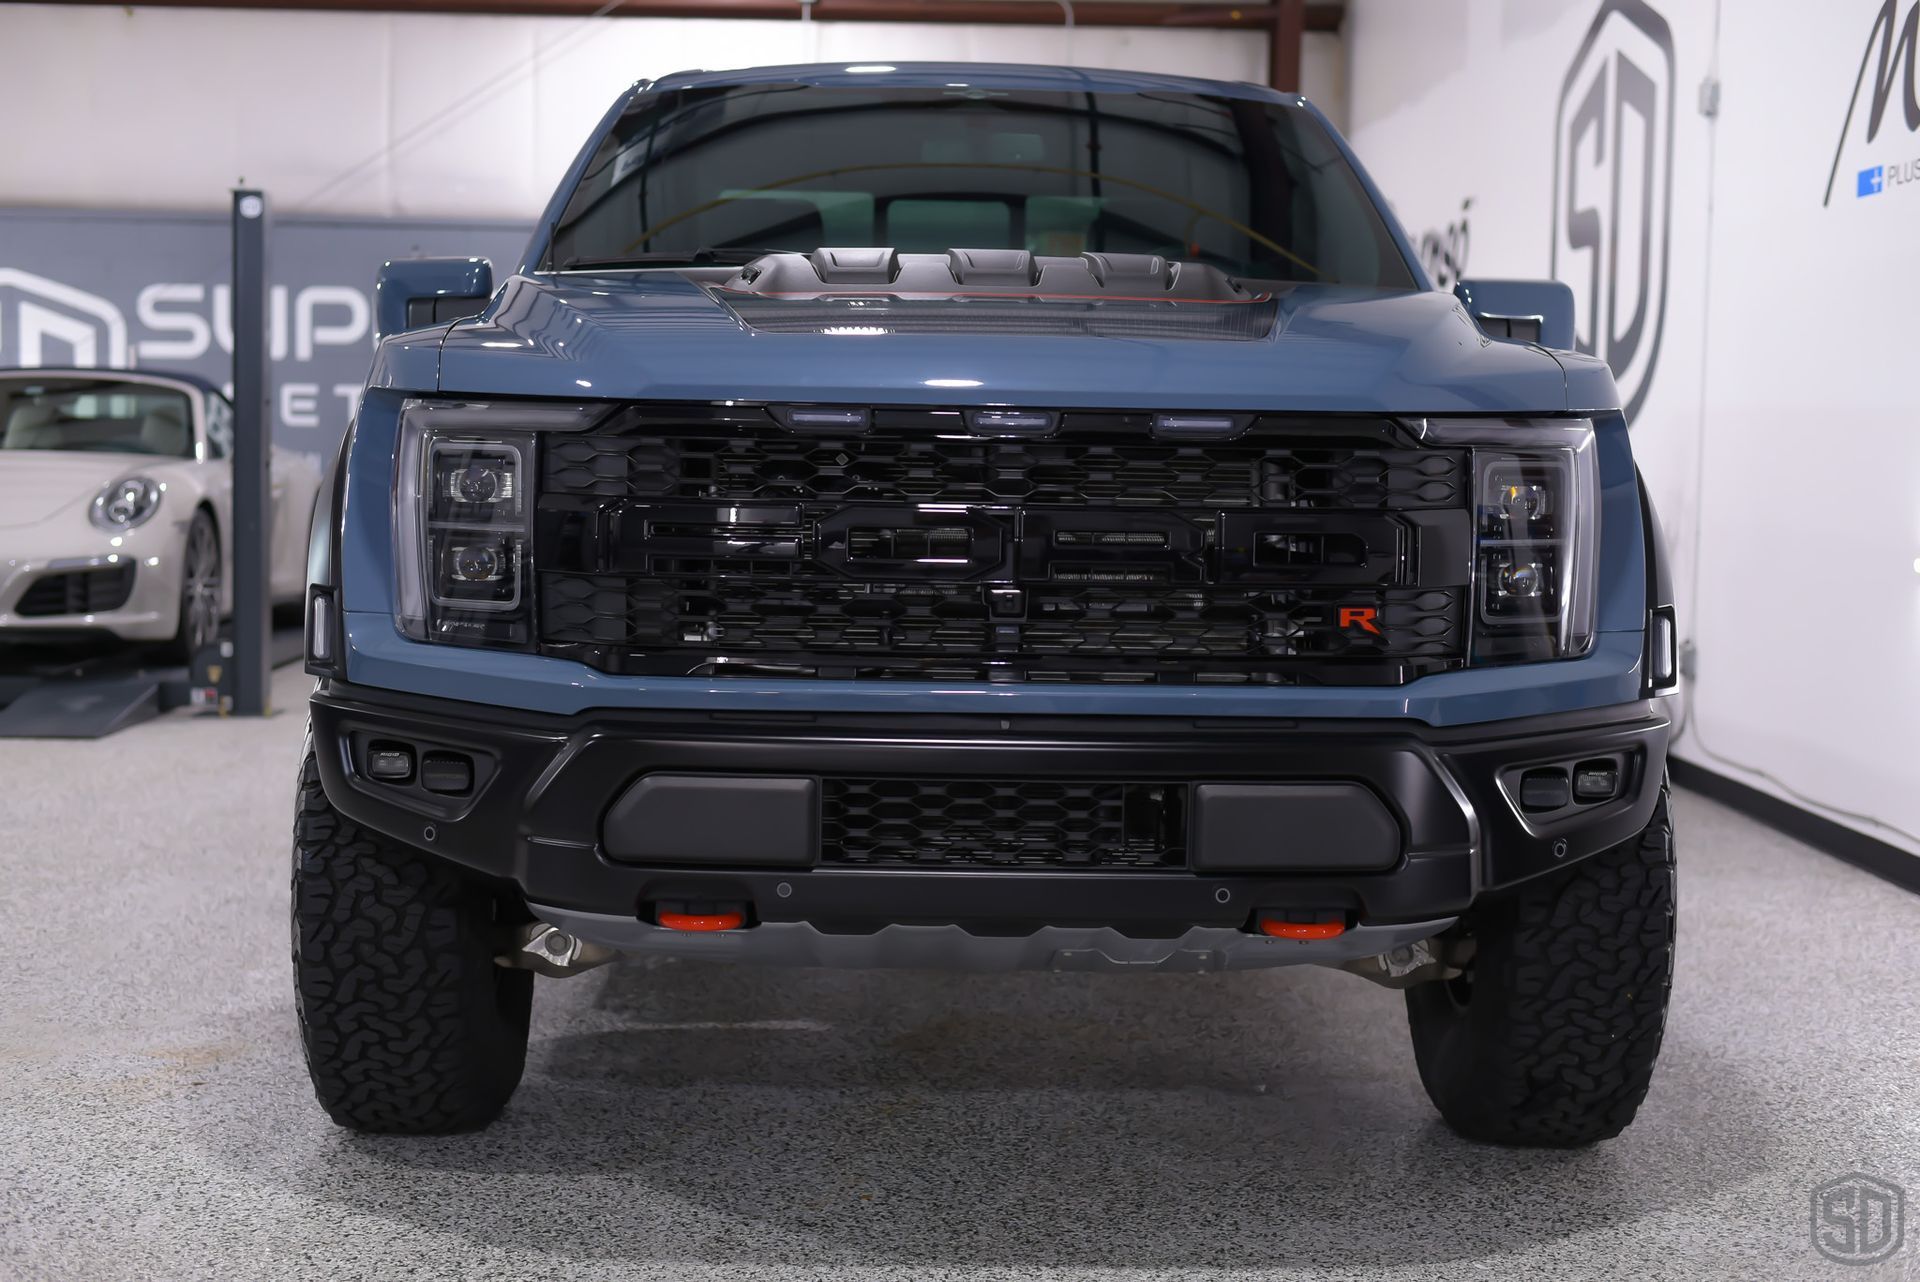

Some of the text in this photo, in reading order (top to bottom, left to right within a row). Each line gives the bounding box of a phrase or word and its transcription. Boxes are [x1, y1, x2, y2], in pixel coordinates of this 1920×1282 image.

[136, 282, 377, 362] SUP
[277, 383, 363, 427] ET
[1339, 607, 1381, 636] R
